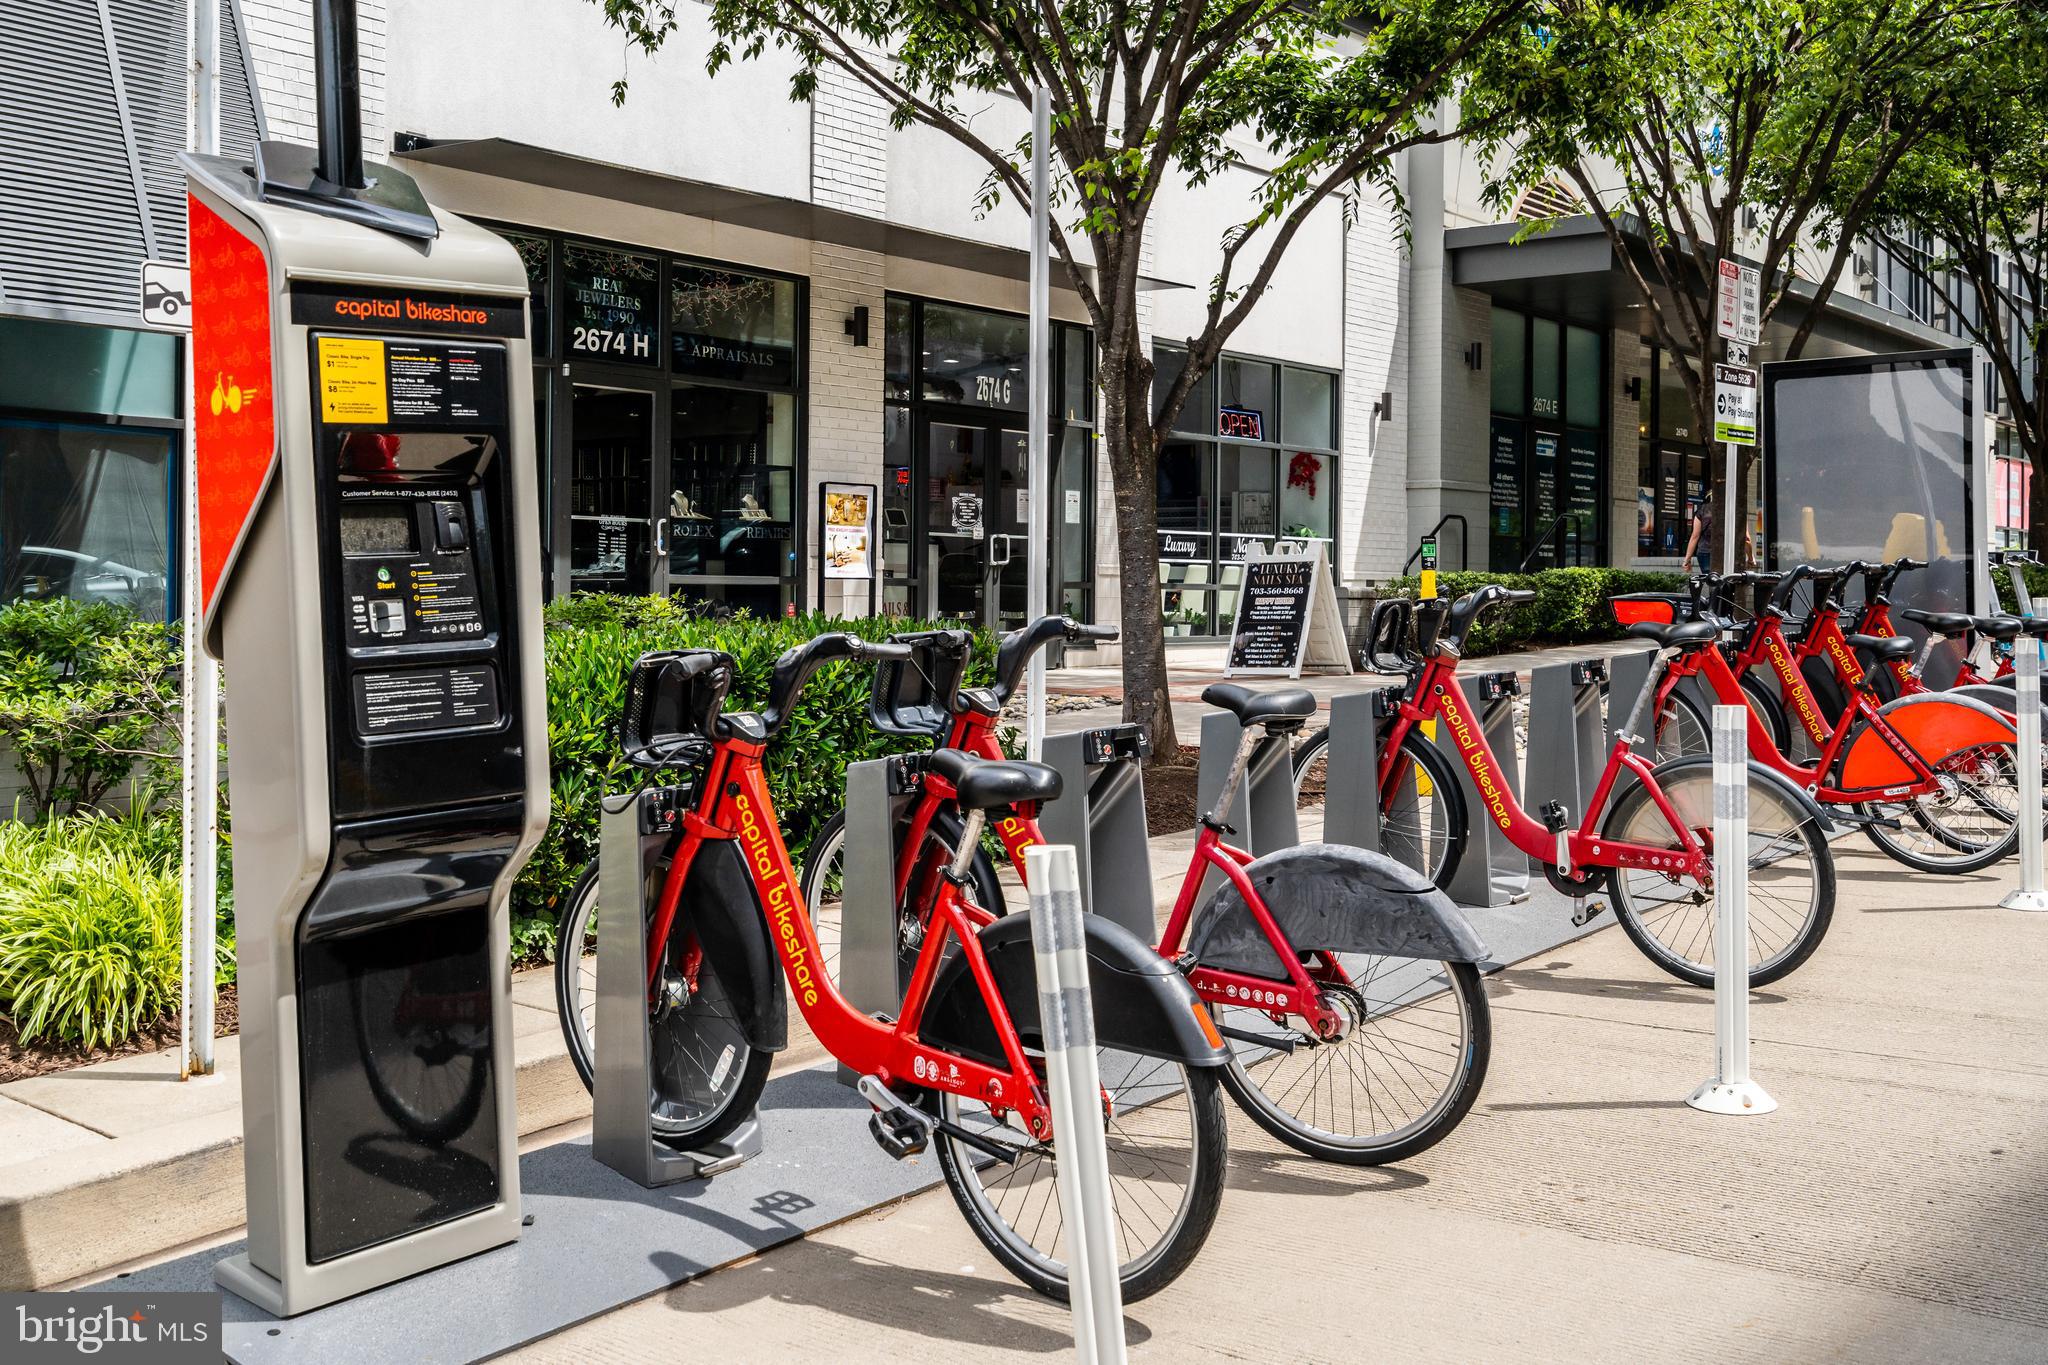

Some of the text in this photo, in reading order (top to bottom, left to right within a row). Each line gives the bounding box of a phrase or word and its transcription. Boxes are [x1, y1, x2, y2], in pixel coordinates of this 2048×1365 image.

[592, 277, 626, 293] REAL
[1743, 272, 1757, 285] NOTICE
[576, 290, 641, 310] JEWELERS
[335, 297, 488, 324] capital bikeshare
[584, 306, 635, 325] Est. 1990
[573, 326, 649, 358] 2674 H
[691, 344, 774, 366] APPRAISALS
[326, 360, 334, 368] $1
[1724, 370, 1738, 383] Zone
[976, 376, 1011, 404] 2674 G
[1534, 398, 1558, 414] 2674 E
[1728, 393, 1742, 406] Pay at
[1728, 406, 1754, 418] Pay Station
[1220, 412, 1260, 438] OPEN
[440, 490, 458, 498] (2453)
[673, 524, 792, 539] ROLEX REPAIRS
[1164, 534, 1197, 558] Luxury
[1260, 564, 1298, 574] LUXURY
[377, 582, 396, 590] Start
[1254, 574, 1303, 585] NAILS SPA
[1250, 587, 1304, 595] 703-560-8668
[1827, 636, 1856, 674] capital
[1770, 644, 1824, 742] capital bikeshare
[1441, 694, 1512, 829] capital bikeshare
[735, 794, 818, 1007] capital bikeshare
